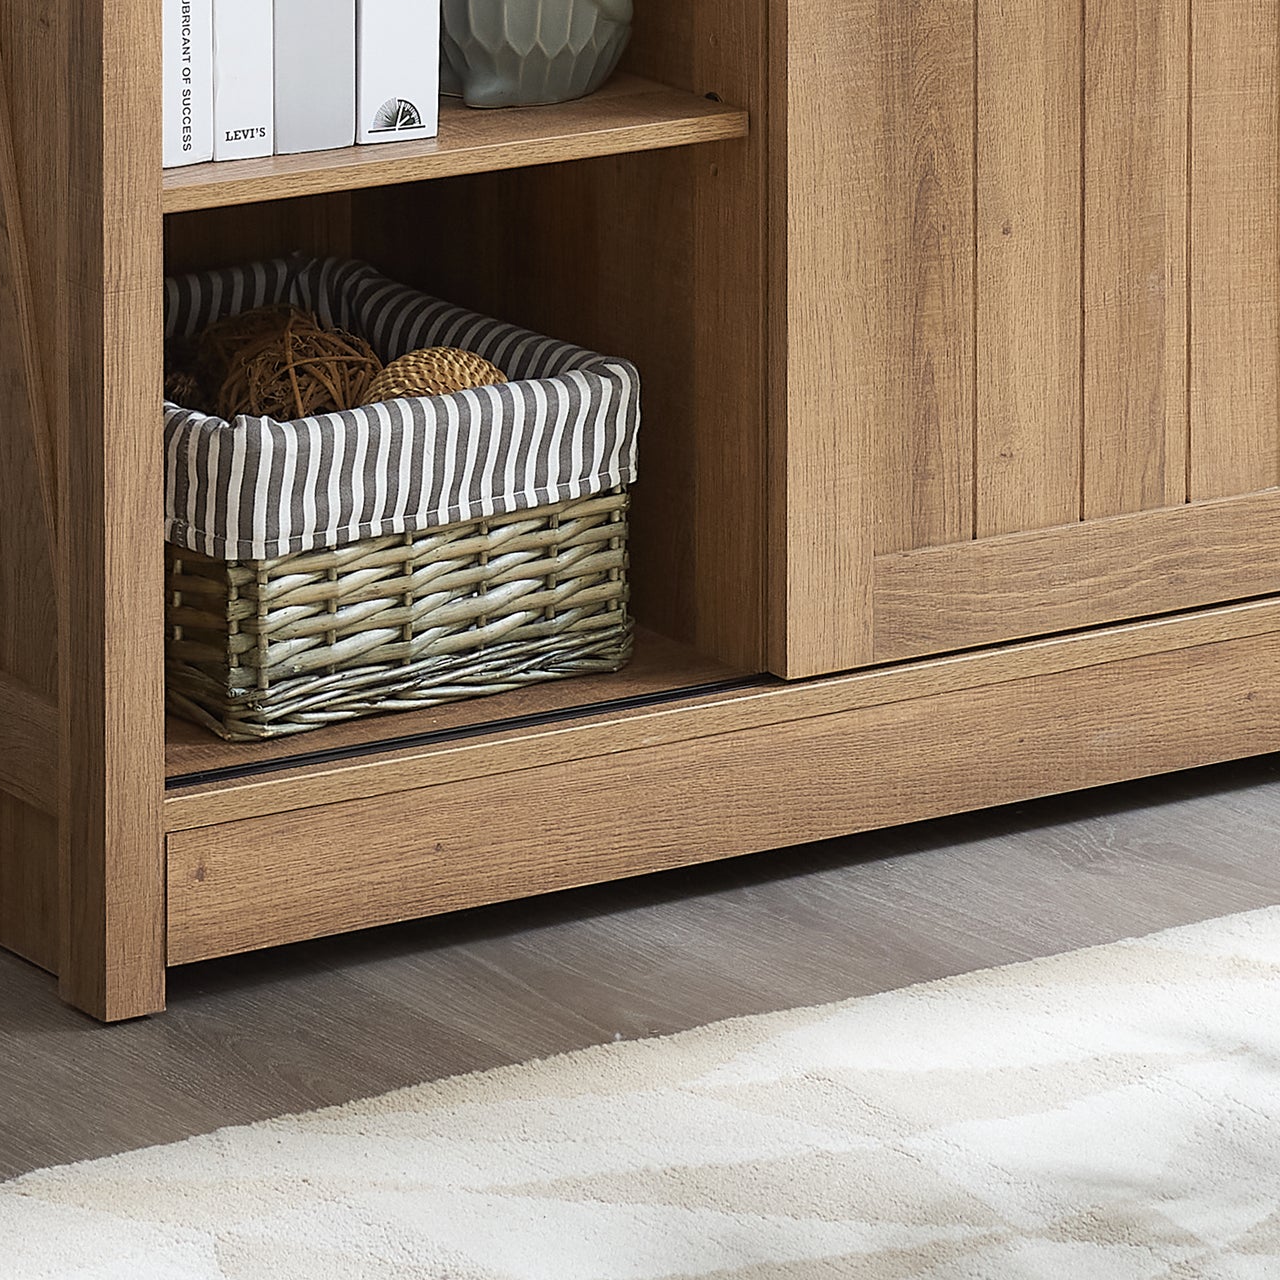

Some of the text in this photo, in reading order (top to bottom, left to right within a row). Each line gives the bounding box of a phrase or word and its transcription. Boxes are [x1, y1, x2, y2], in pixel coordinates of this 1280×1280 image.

[182, 67, 192, 85] OF
[182, 89, 192, 152] SUCCESS
[225, 127, 266, 141] LEVI'S
